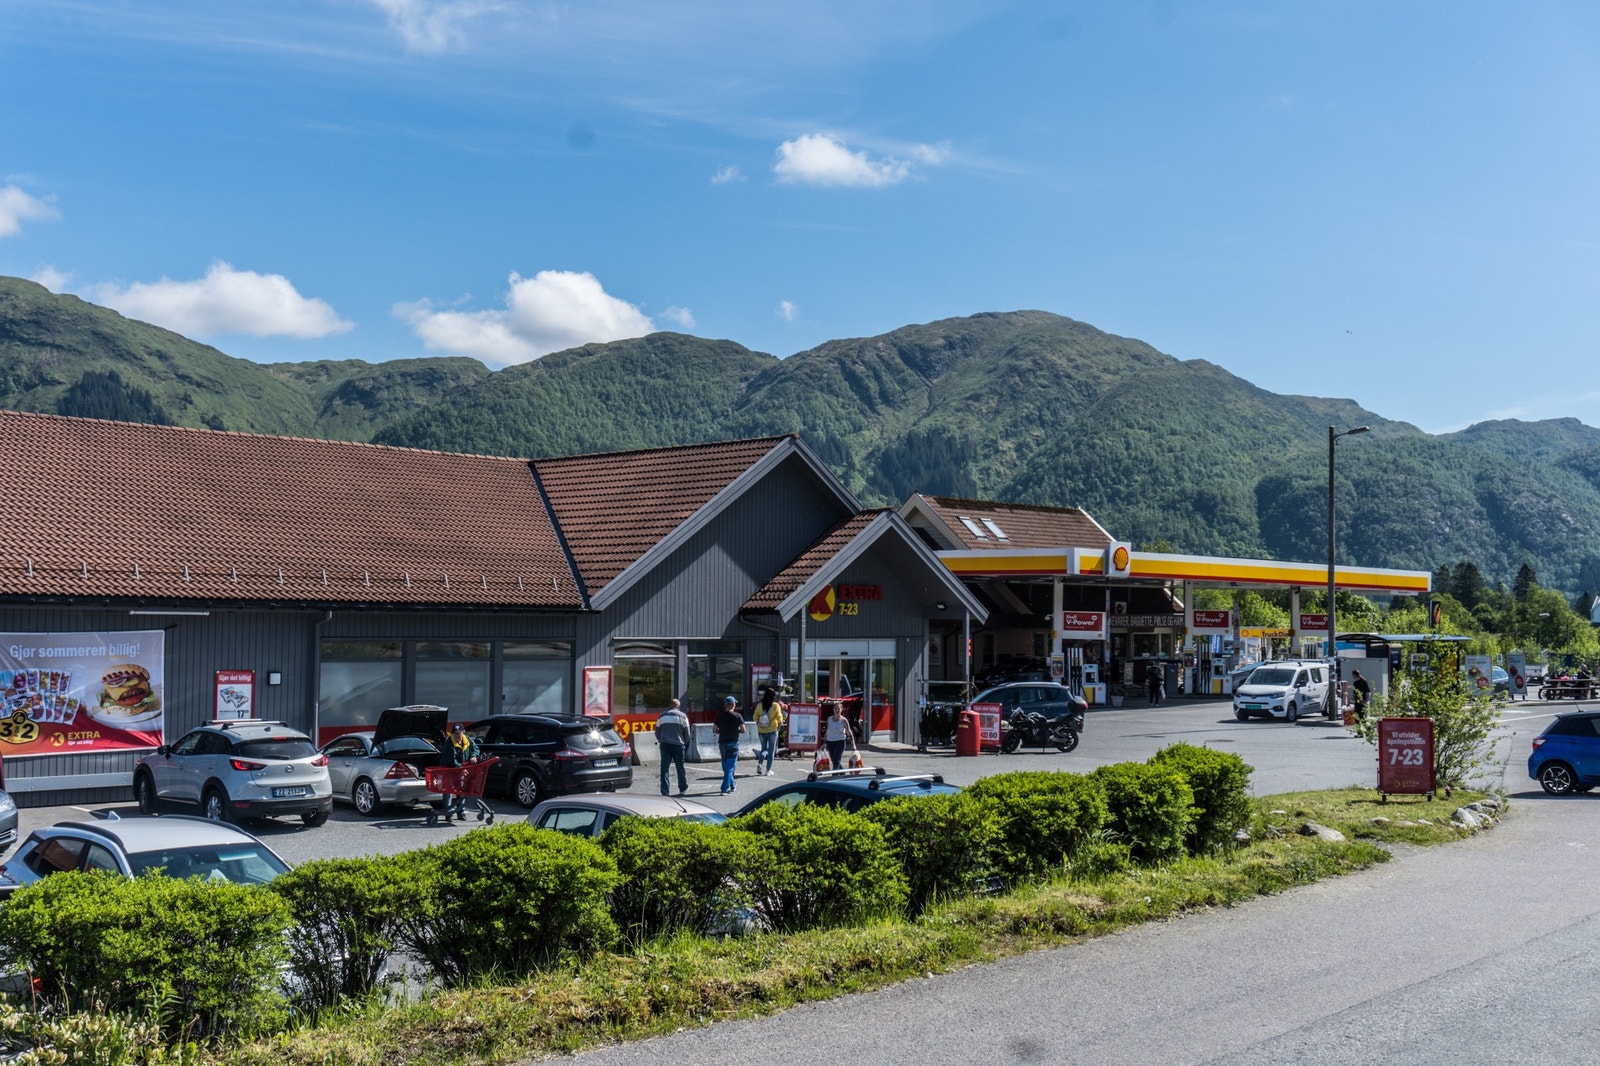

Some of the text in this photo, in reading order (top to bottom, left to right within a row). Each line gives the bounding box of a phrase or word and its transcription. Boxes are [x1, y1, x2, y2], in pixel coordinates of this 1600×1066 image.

[838, 584, 883, 601] EXTRA
[839, 603, 858, 615] 7-23
[1174, 615, 1184, 627] HAM
[1261, 630, 1289, 638] TruckDie
[10, 643, 141, 661] Gjør sommeren billig!
[0, 722, 13, 738] 3
[21, 723, 34, 739] 2
[632, 721, 657, 732] EXT
[67, 730, 101, 740] EXTRA
[802, 734, 816, 742] 299
[1388, 748, 1424, 766] 7-23
